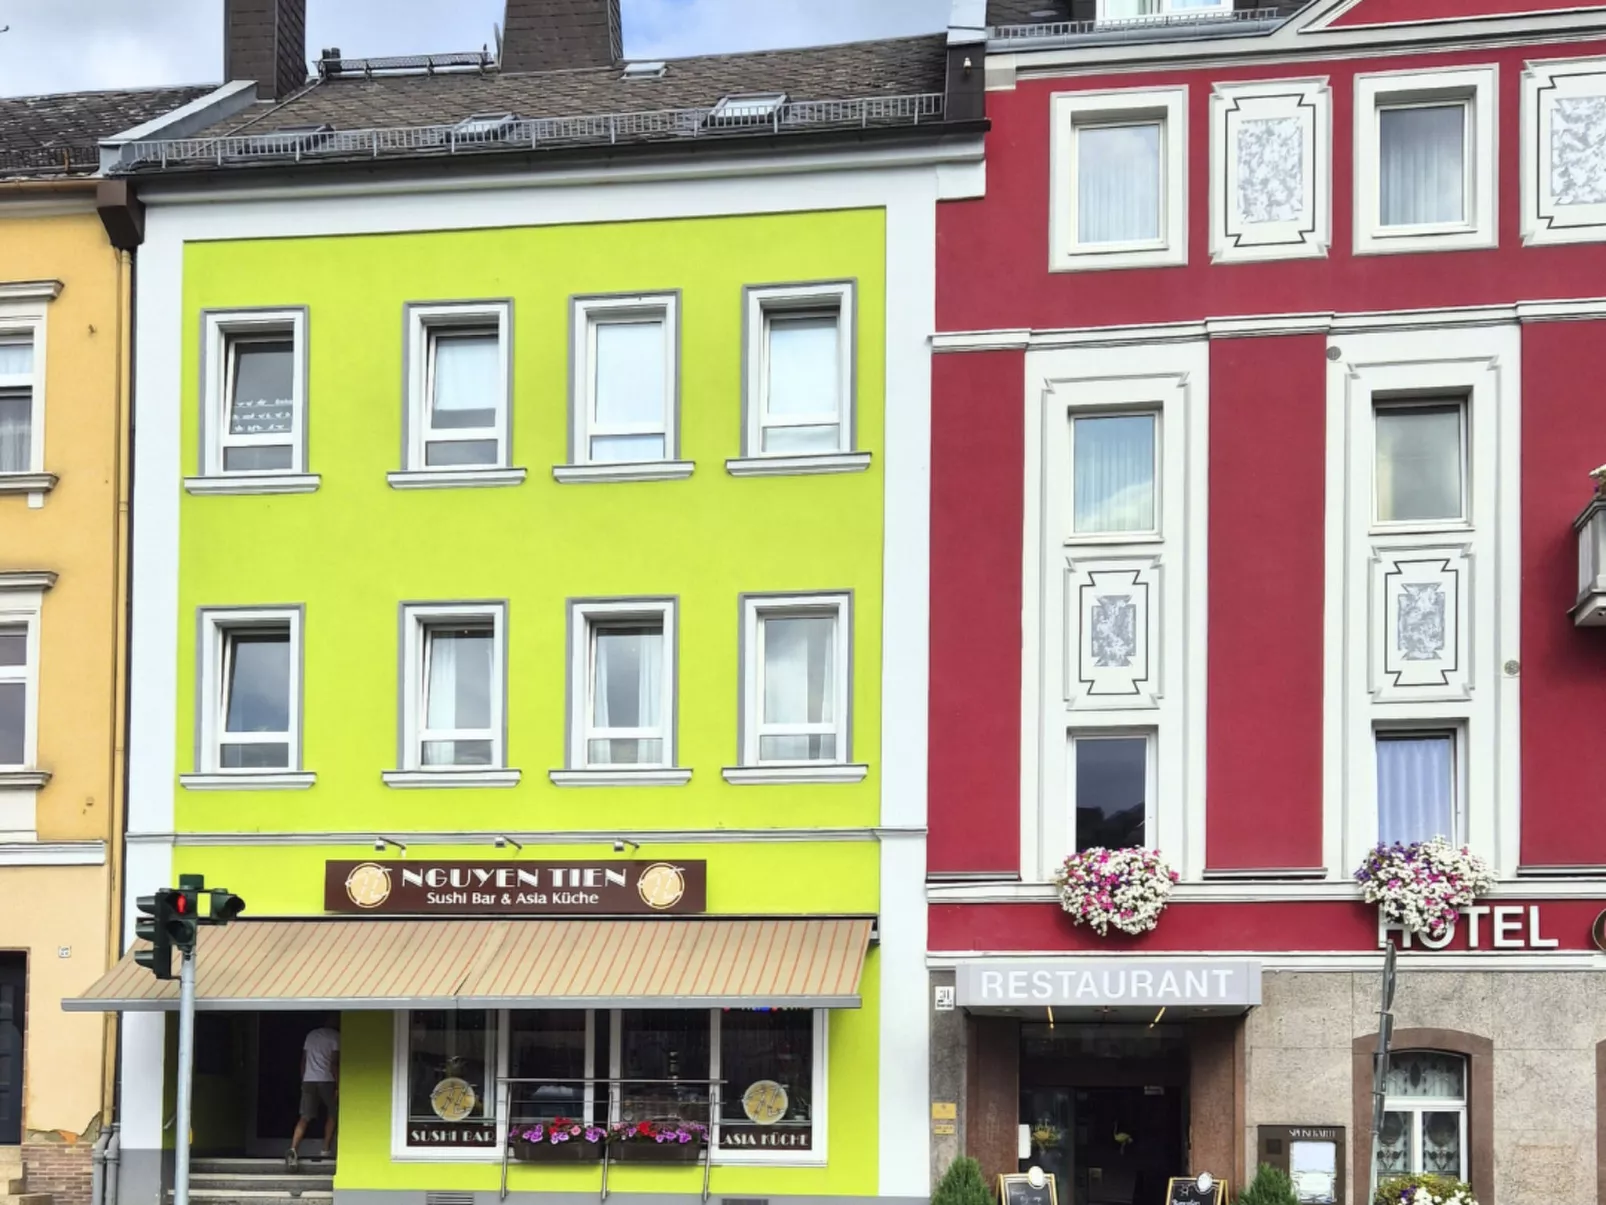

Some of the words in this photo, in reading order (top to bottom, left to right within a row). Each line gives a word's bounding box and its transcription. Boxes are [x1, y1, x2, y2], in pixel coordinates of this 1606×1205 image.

[402, 868, 539, 887] NGUYEN
[549, 868, 627, 887] TIEN
[426, 891, 467, 904] Sushi
[472, 891, 496, 904] Bar
[501, 892, 511, 904] &
[516, 891, 547, 904] Asia
[552, 890, 599, 904] Küche
[981, 969, 1234, 1000] RESTAURANT
[411, 1130, 457, 1141] SUSHI
[462, 1130, 494, 1141] BAR
[724, 1133, 757, 1145] ASIA
[761, 1132, 808, 1146] KÜCHE
